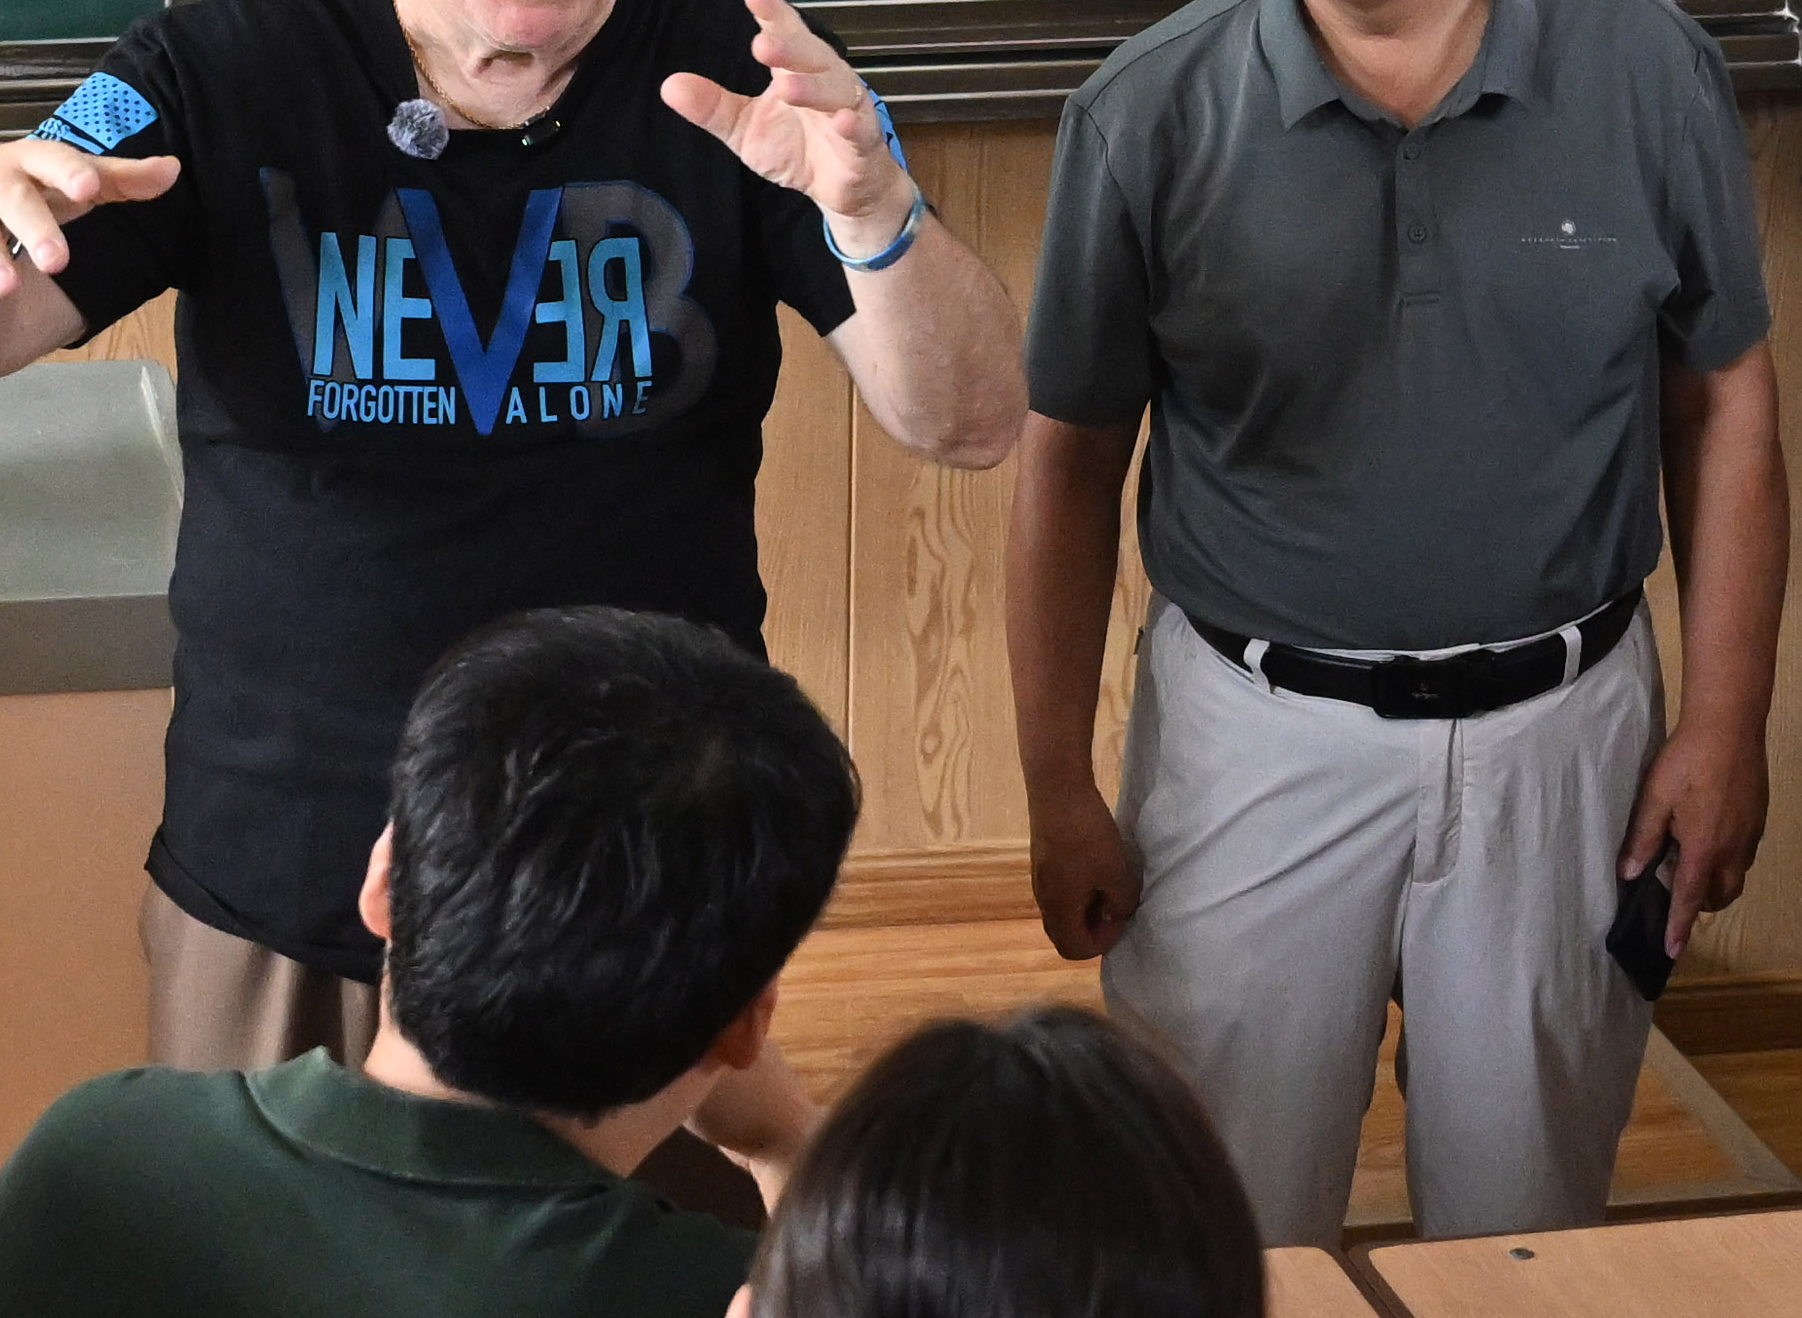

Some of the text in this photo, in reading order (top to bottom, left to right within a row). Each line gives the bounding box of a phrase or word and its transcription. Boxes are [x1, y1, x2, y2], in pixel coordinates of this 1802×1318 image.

[311, 186, 653, 436] NEVER
[306, 379, 654, 425] FORGOTTEN ALONE
